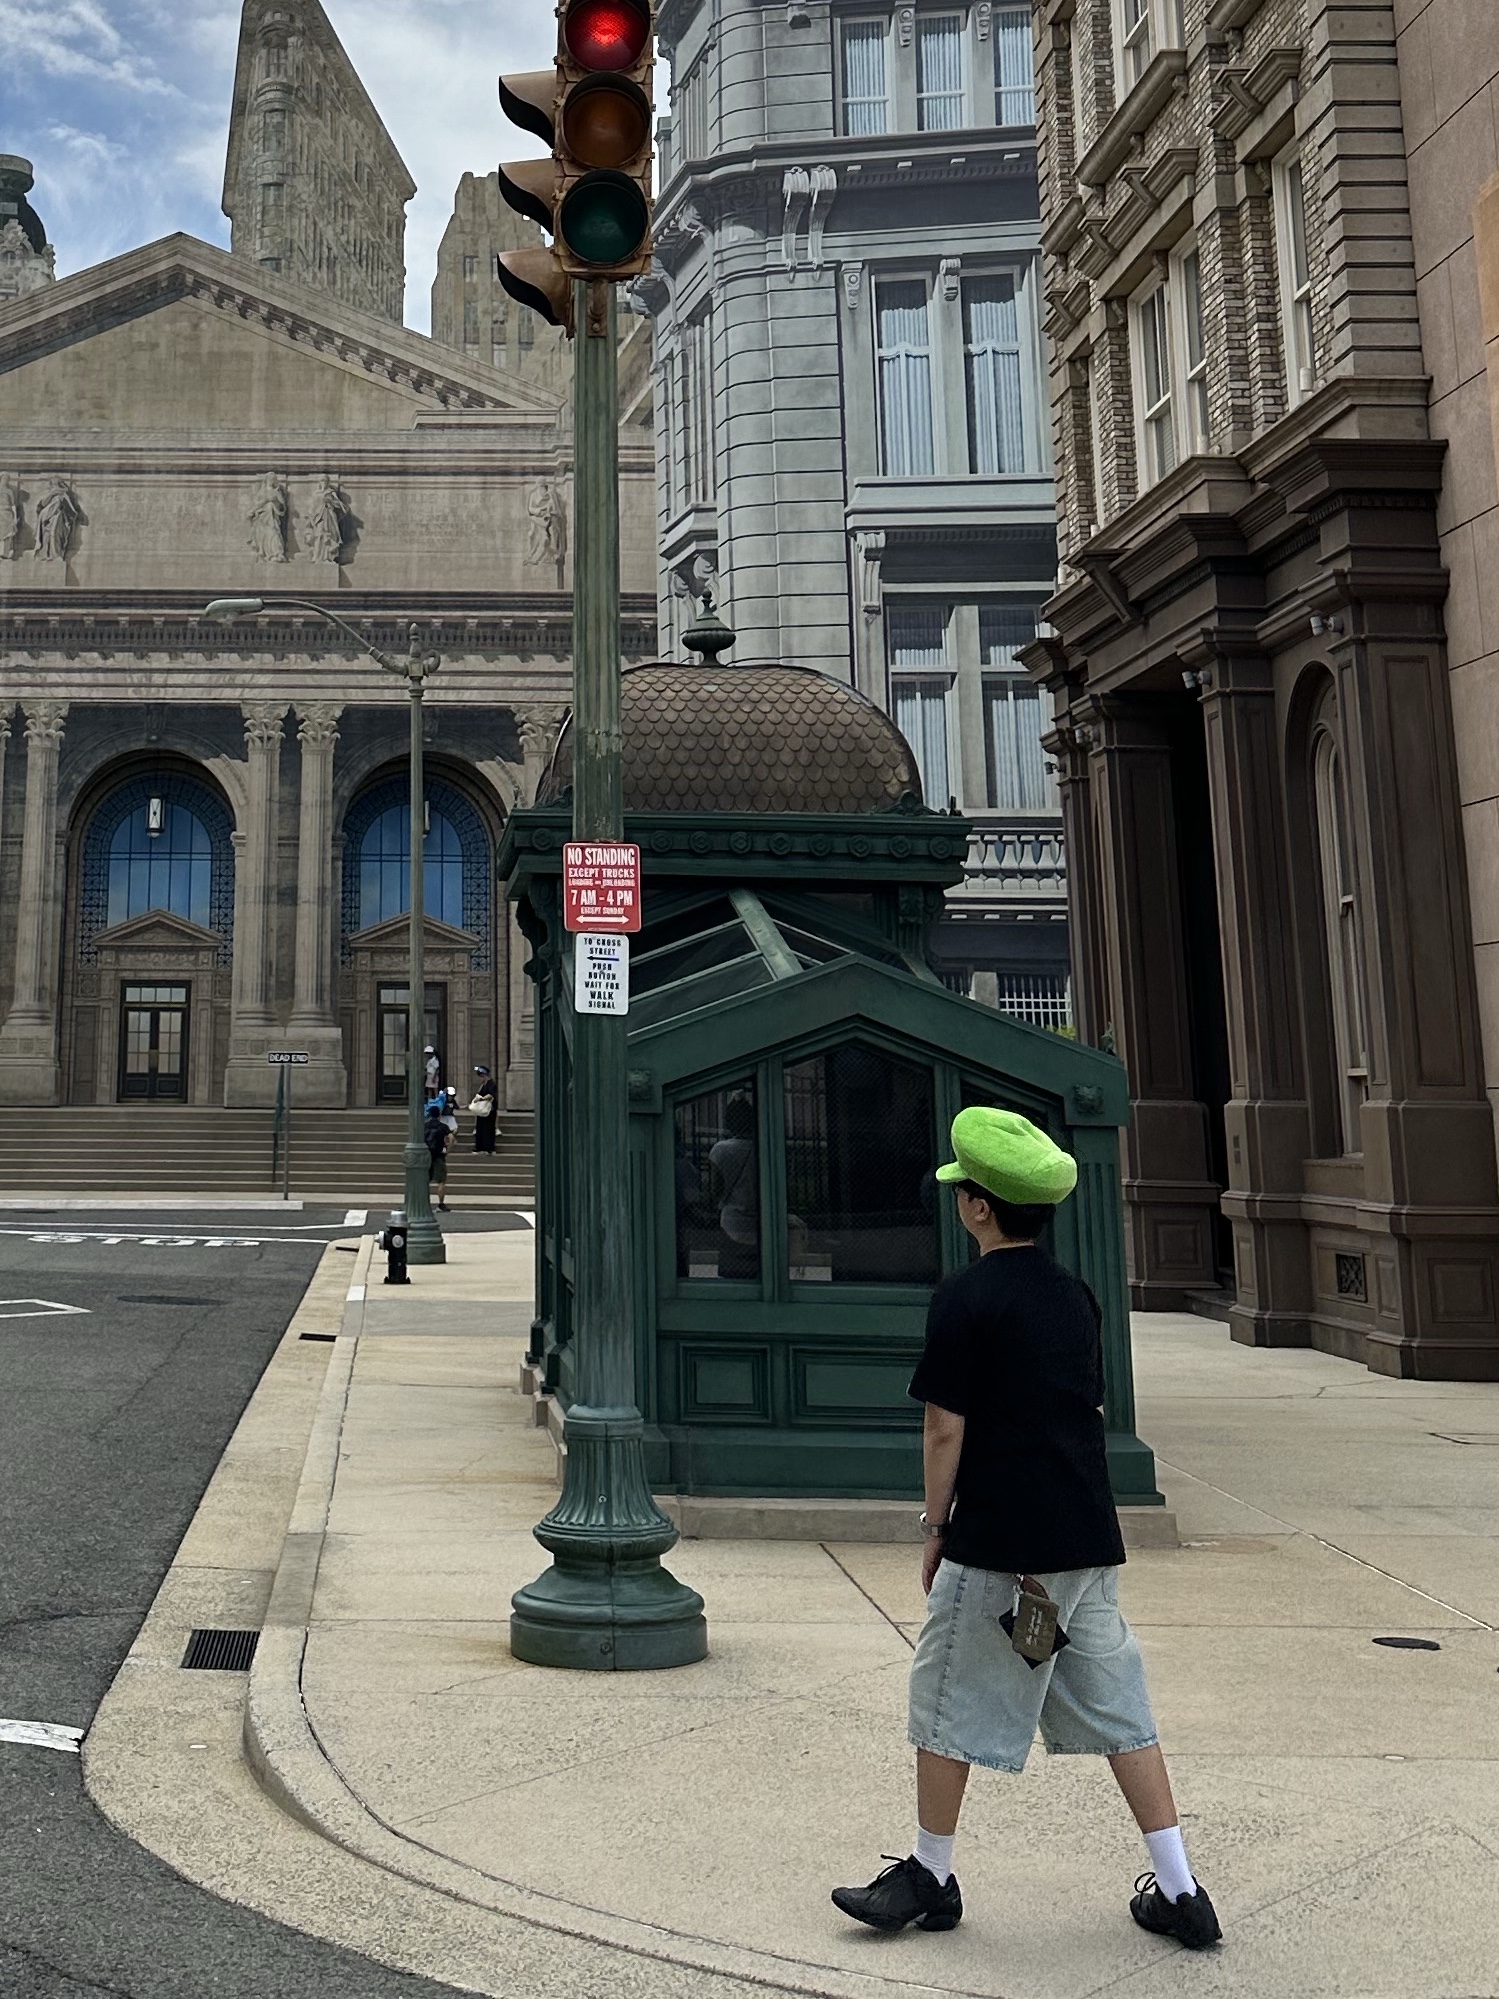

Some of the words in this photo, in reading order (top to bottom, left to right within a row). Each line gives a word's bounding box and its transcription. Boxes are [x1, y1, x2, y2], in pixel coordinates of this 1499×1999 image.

[567, 847, 582, 865] NO
[585, 848, 636, 866] STANDING
[568, 868, 599, 878] EXCEPT
[601, 868, 635, 879] TRUCKS
[571, 889, 578, 906] 7
[580, 889, 597, 906] AM
[606, 890, 614, 906] 4
[616, 890, 633, 906] PM
[580, 907, 601, 915] EXCEPT
[602, 907, 625, 915] SUNDAY
[583, 937, 593, 946] TO
[596, 938, 622, 947] CROSS
[589, 947, 616, 956] STREET
[592, 962, 613, 971] PUSH
[588, 971, 617, 981] BUTTON
[584, 981, 602, 989] WAIT
[605, 981, 620, 990] FOR
[589, 990, 614, 1000] WALK
[588, 1000, 616, 1010] SIGNAL
[269, 1053, 290, 1062] DEAD
[291, 1054, 308, 1062] END
[27, 1234, 260, 1247] STOP
